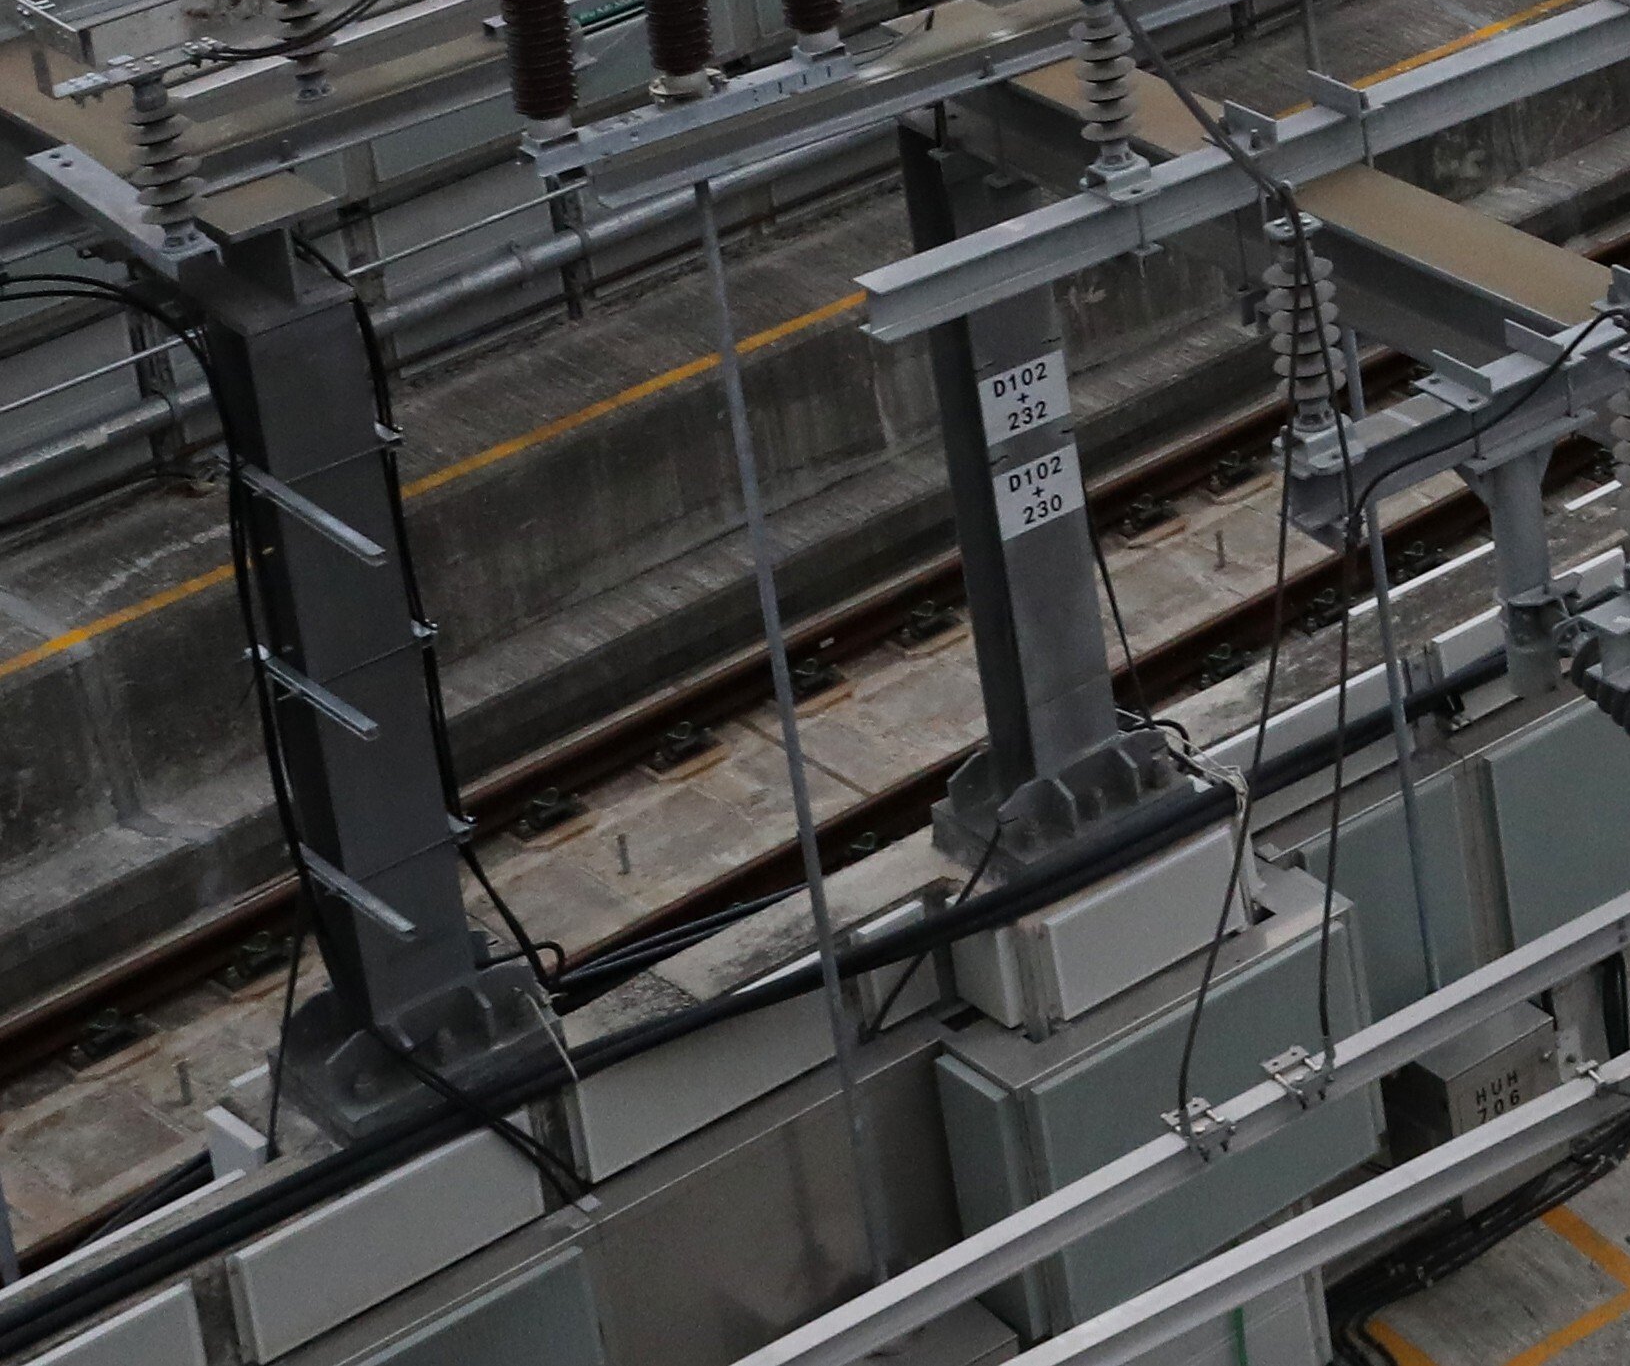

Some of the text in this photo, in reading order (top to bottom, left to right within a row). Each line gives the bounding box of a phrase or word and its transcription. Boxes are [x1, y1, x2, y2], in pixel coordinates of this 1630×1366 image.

[993, 362, 1048, 398] D102
[1008, 401, 1048, 431] 232
[1008, 456, 1063, 493] D102
[1023, 494, 1063, 525] 230
[1476, 1070, 1518, 1106] HUH
[1477, 1089, 1520, 1124] 706
